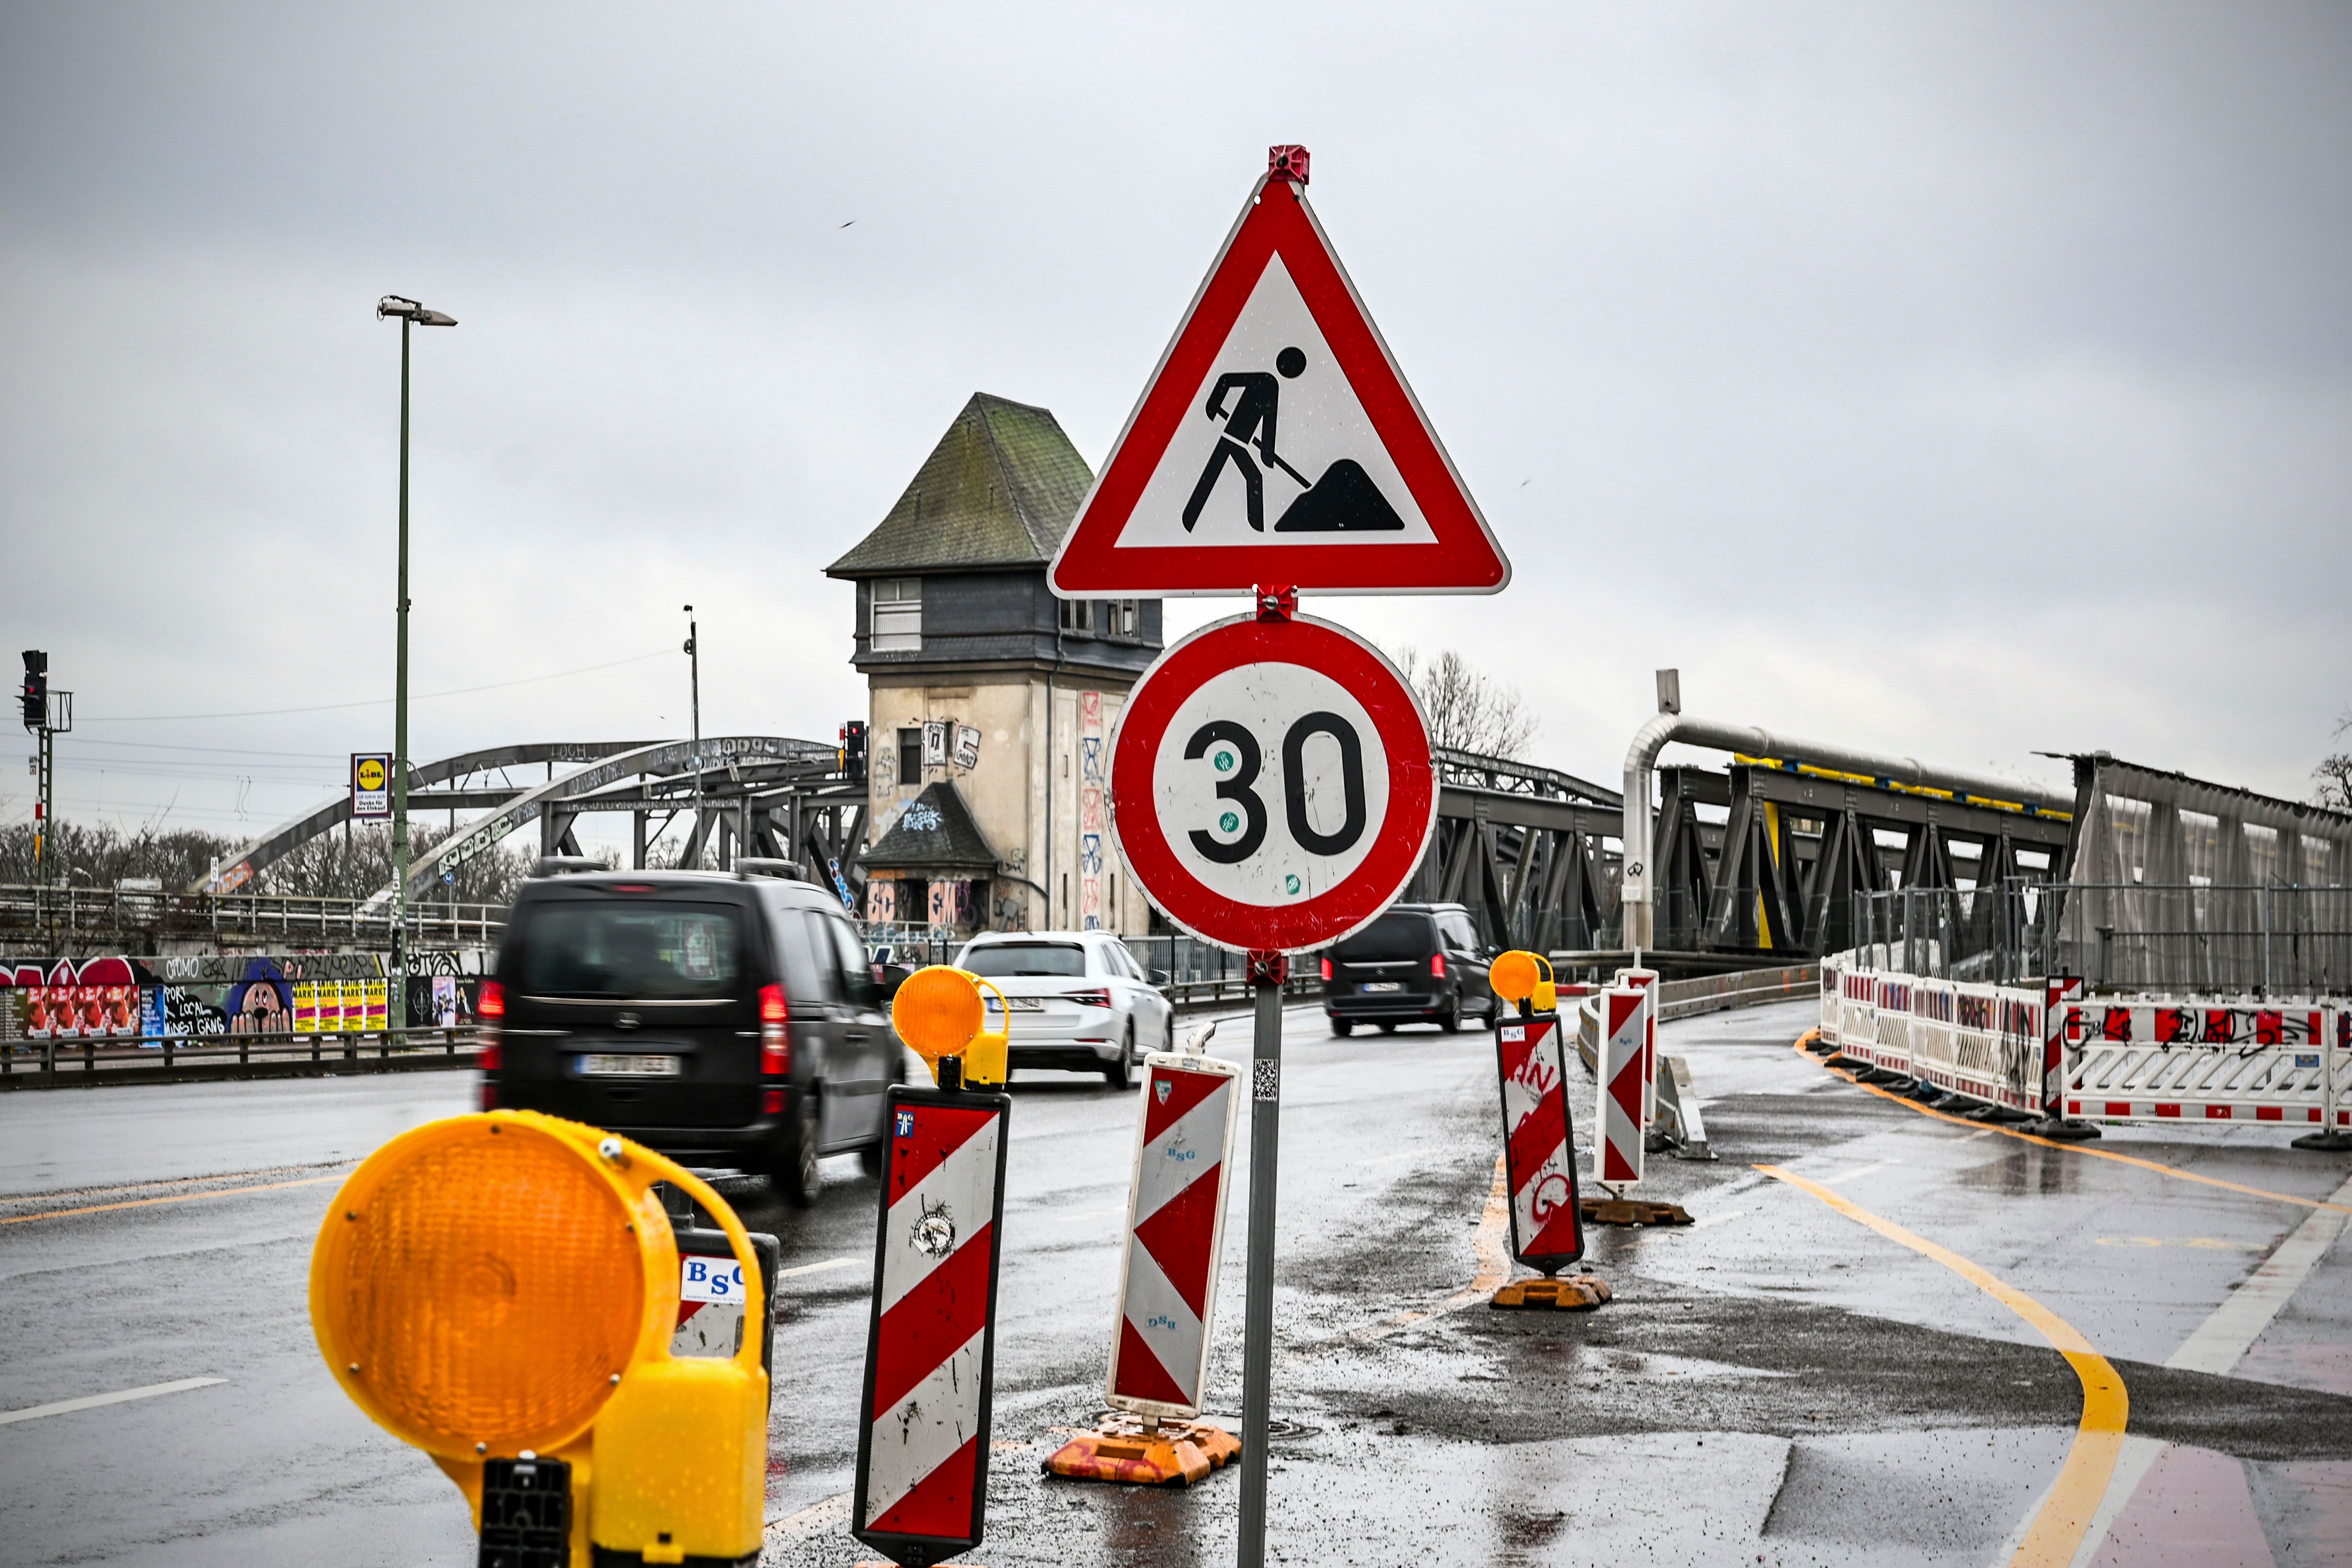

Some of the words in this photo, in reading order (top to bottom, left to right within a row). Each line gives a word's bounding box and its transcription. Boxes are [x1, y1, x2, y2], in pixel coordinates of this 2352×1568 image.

[1184, 711, 1366, 864] 30
[292, 989, 316, 999] MARKT
[317, 989, 339, 998] MARKT
[341, 988, 363, 998] MARKT
[364, 987, 386, 997] MARKT
[179, 1001, 212, 1017] LOCAL
[197, 1016, 225, 1035] GÄNG
[1504, 1028, 1523, 1039] BSG
[1168, 1148, 1195, 1162] BSG
[1148, 1315, 1176, 1329] BSG
